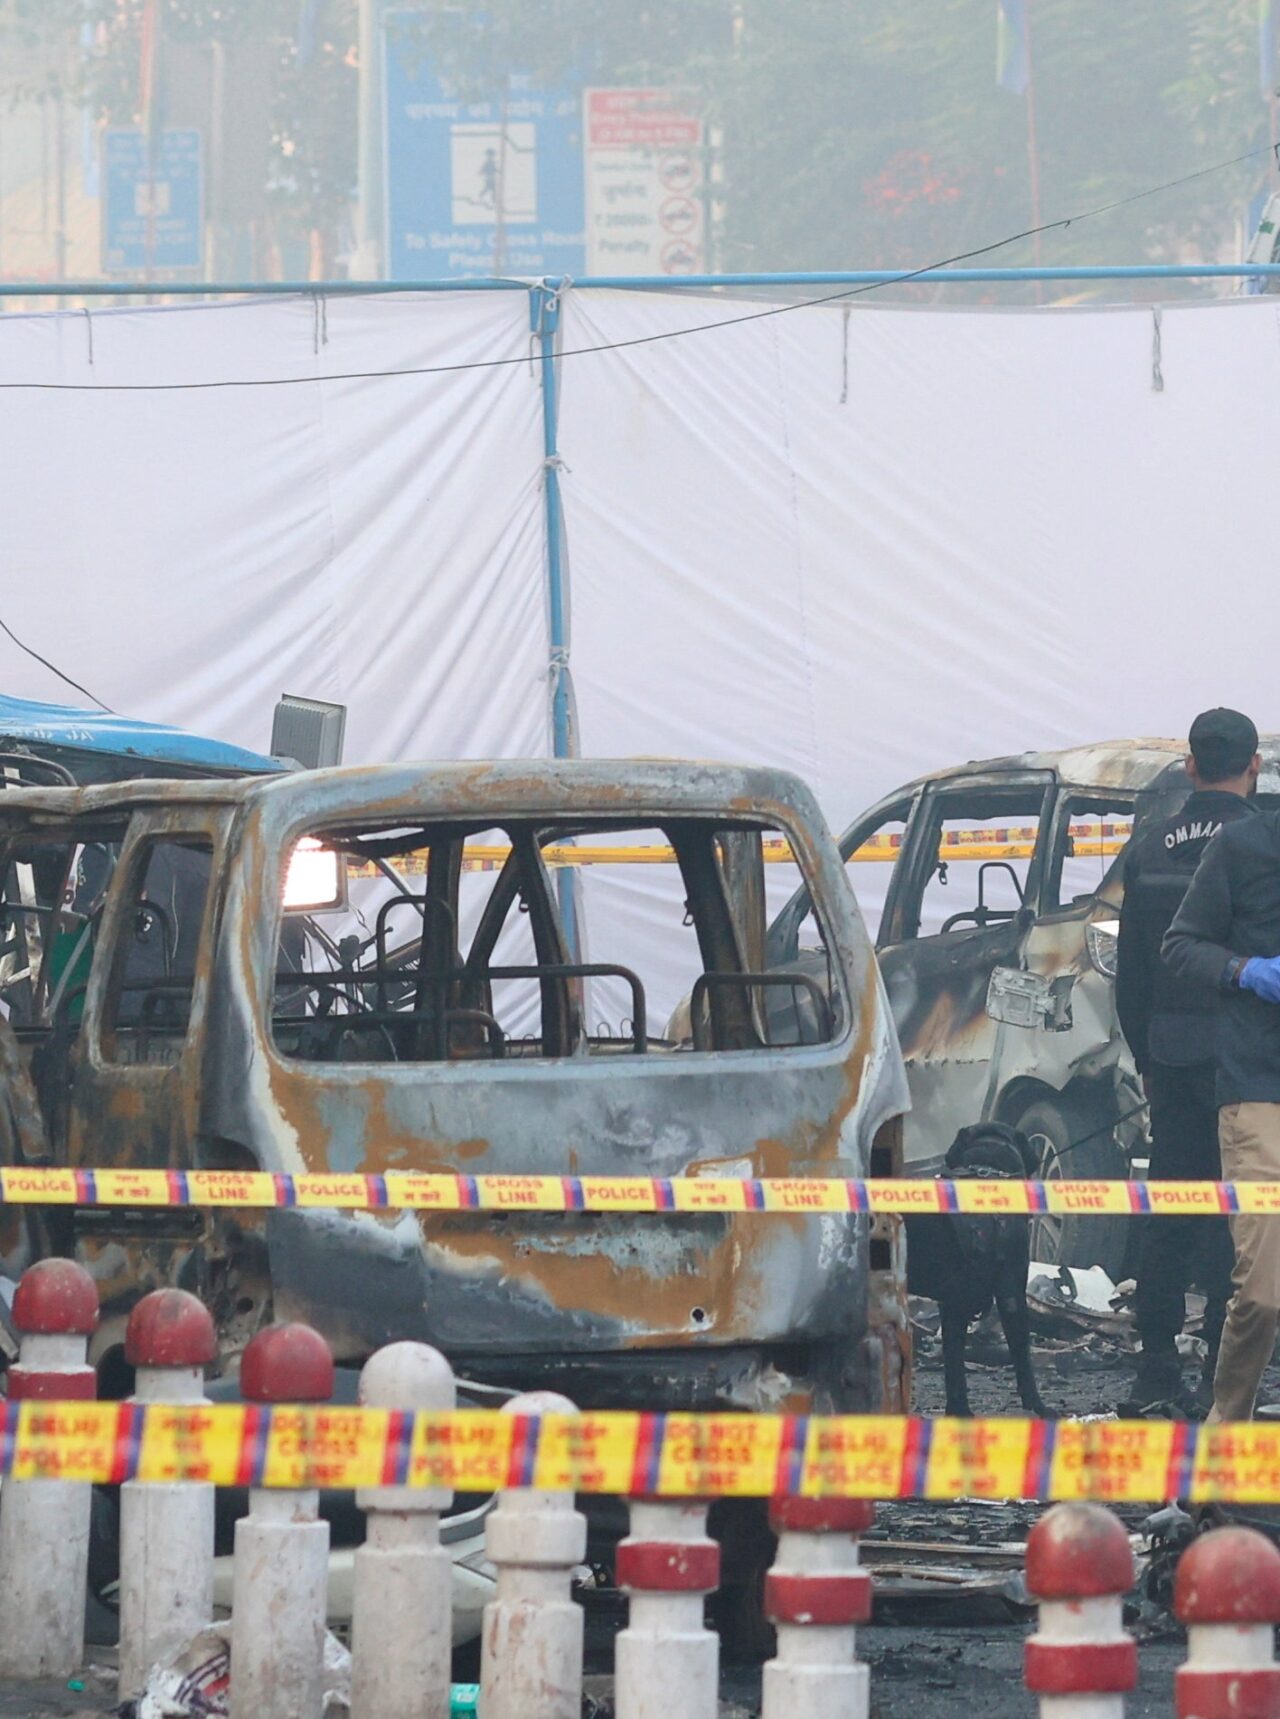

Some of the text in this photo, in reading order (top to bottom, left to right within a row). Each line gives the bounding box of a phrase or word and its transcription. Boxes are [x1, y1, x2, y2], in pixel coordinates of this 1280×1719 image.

[8, 1179, 71, 1191] POLICE
[300, 1184, 363, 1196] POLICE
[208, 1188, 250, 1200] LINE
[498, 1191, 538, 1204] LINE
[586, 1188, 649, 1200] POLICE
[783, 1194, 824, 1207] LINE
[871, 1189, 933, 1202] POLICE
[1152, 1191, 1214, 1204] POLICE
[1066, 1196, 1104, 1208] LINE
[272, 1416, 363, 1434] DO NOT
[668, 1422, 756, 1440] DO NOT
[1060, 1429, 1148, 1446] DO NOT
[279, 1438, 358, 1456] CROSS
[673, 1447, 750, 1463] CROSS
[1064, 1452, 1142, 1469] CROSS
[292, 1464, 345, 1482] LINE
[686, 1471, 737, 1486] LINE
[1198, 1470, 1280, 1489] POLICE
[1077, 1476, 1128, 1493] LINE
